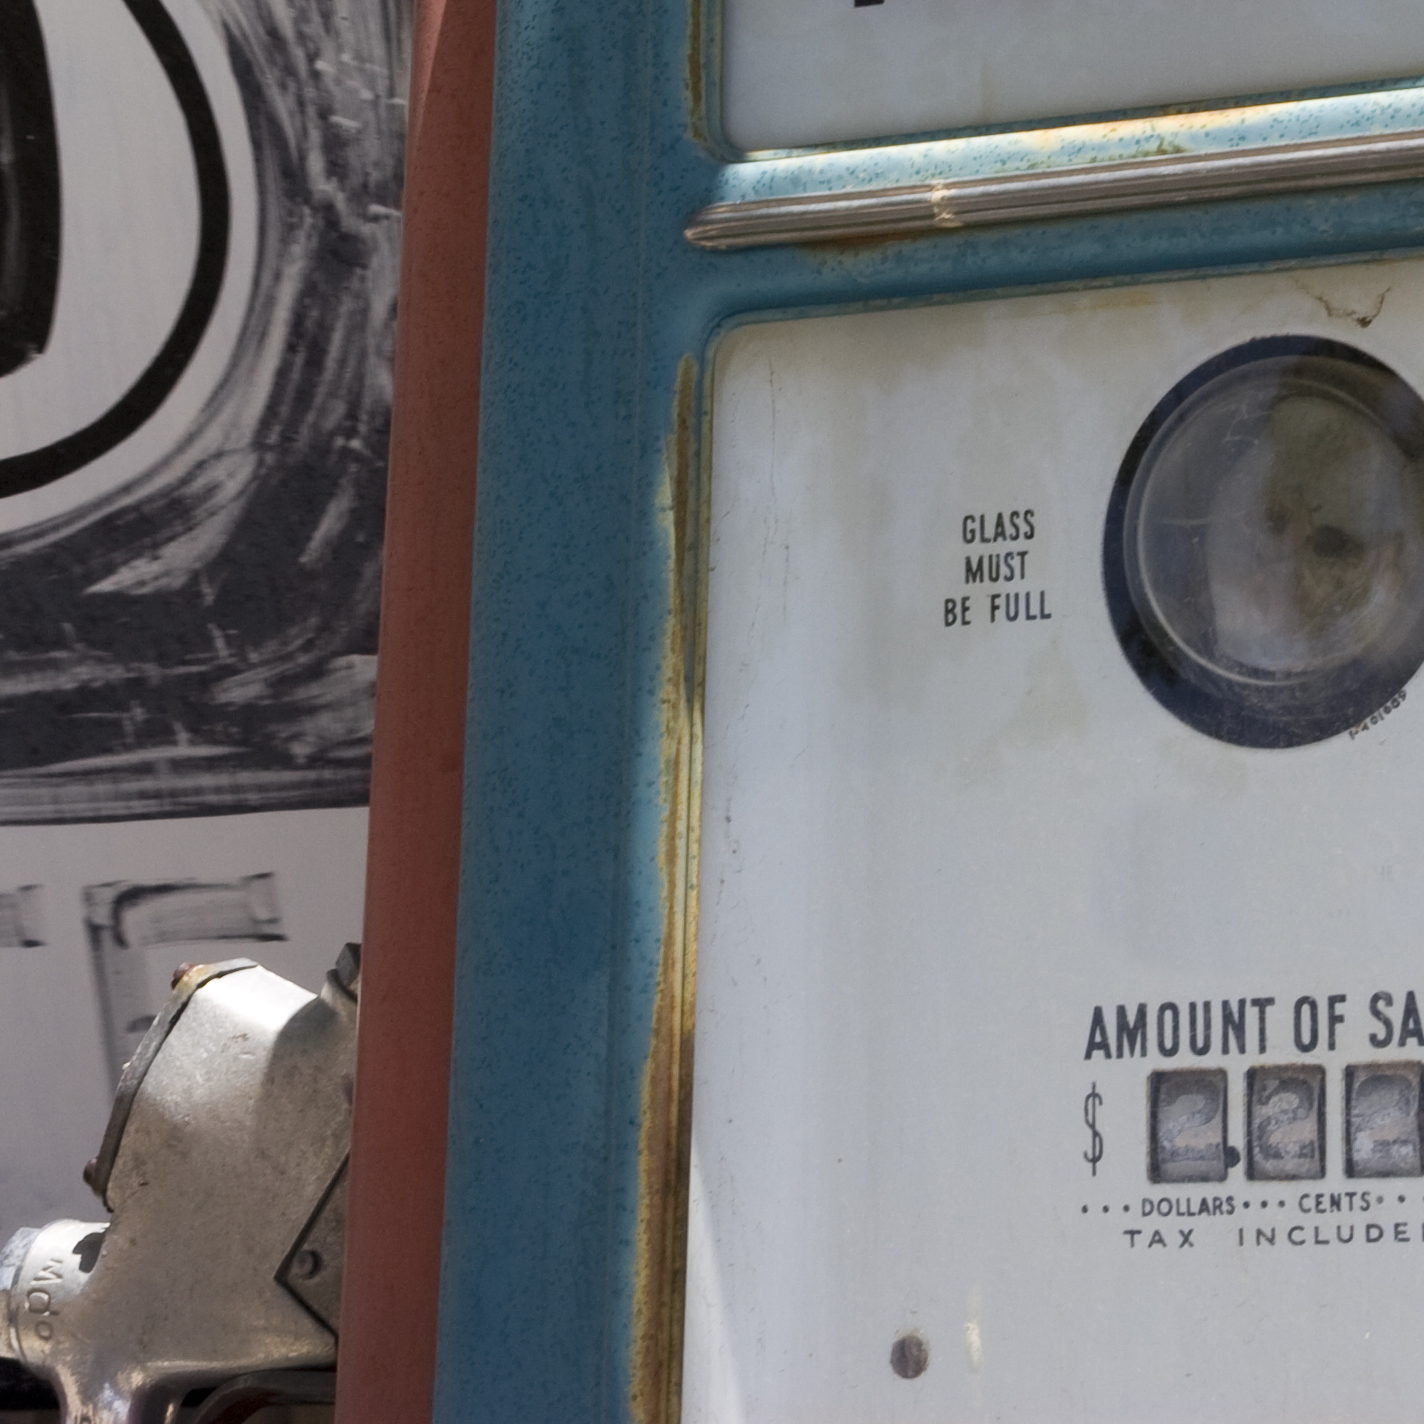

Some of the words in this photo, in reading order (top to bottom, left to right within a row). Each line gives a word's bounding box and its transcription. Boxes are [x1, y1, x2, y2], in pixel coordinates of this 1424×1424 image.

[962, 509, 1035, 544] GLASS
[965, 551, 1029, 584] MUST
[944, 597, 971, 627] BE
[990, 590, 1052, 623] FULL
[1083, 997, 1275, 1060] AMOUNT
[1293, 994, 1347, 1053] OF
[1140, 1195, 1235, 1217] DOLLARS
[1298, 1191, 1371, 1214] CENTS
[1123, 1229, 1195, 1249] TAX
